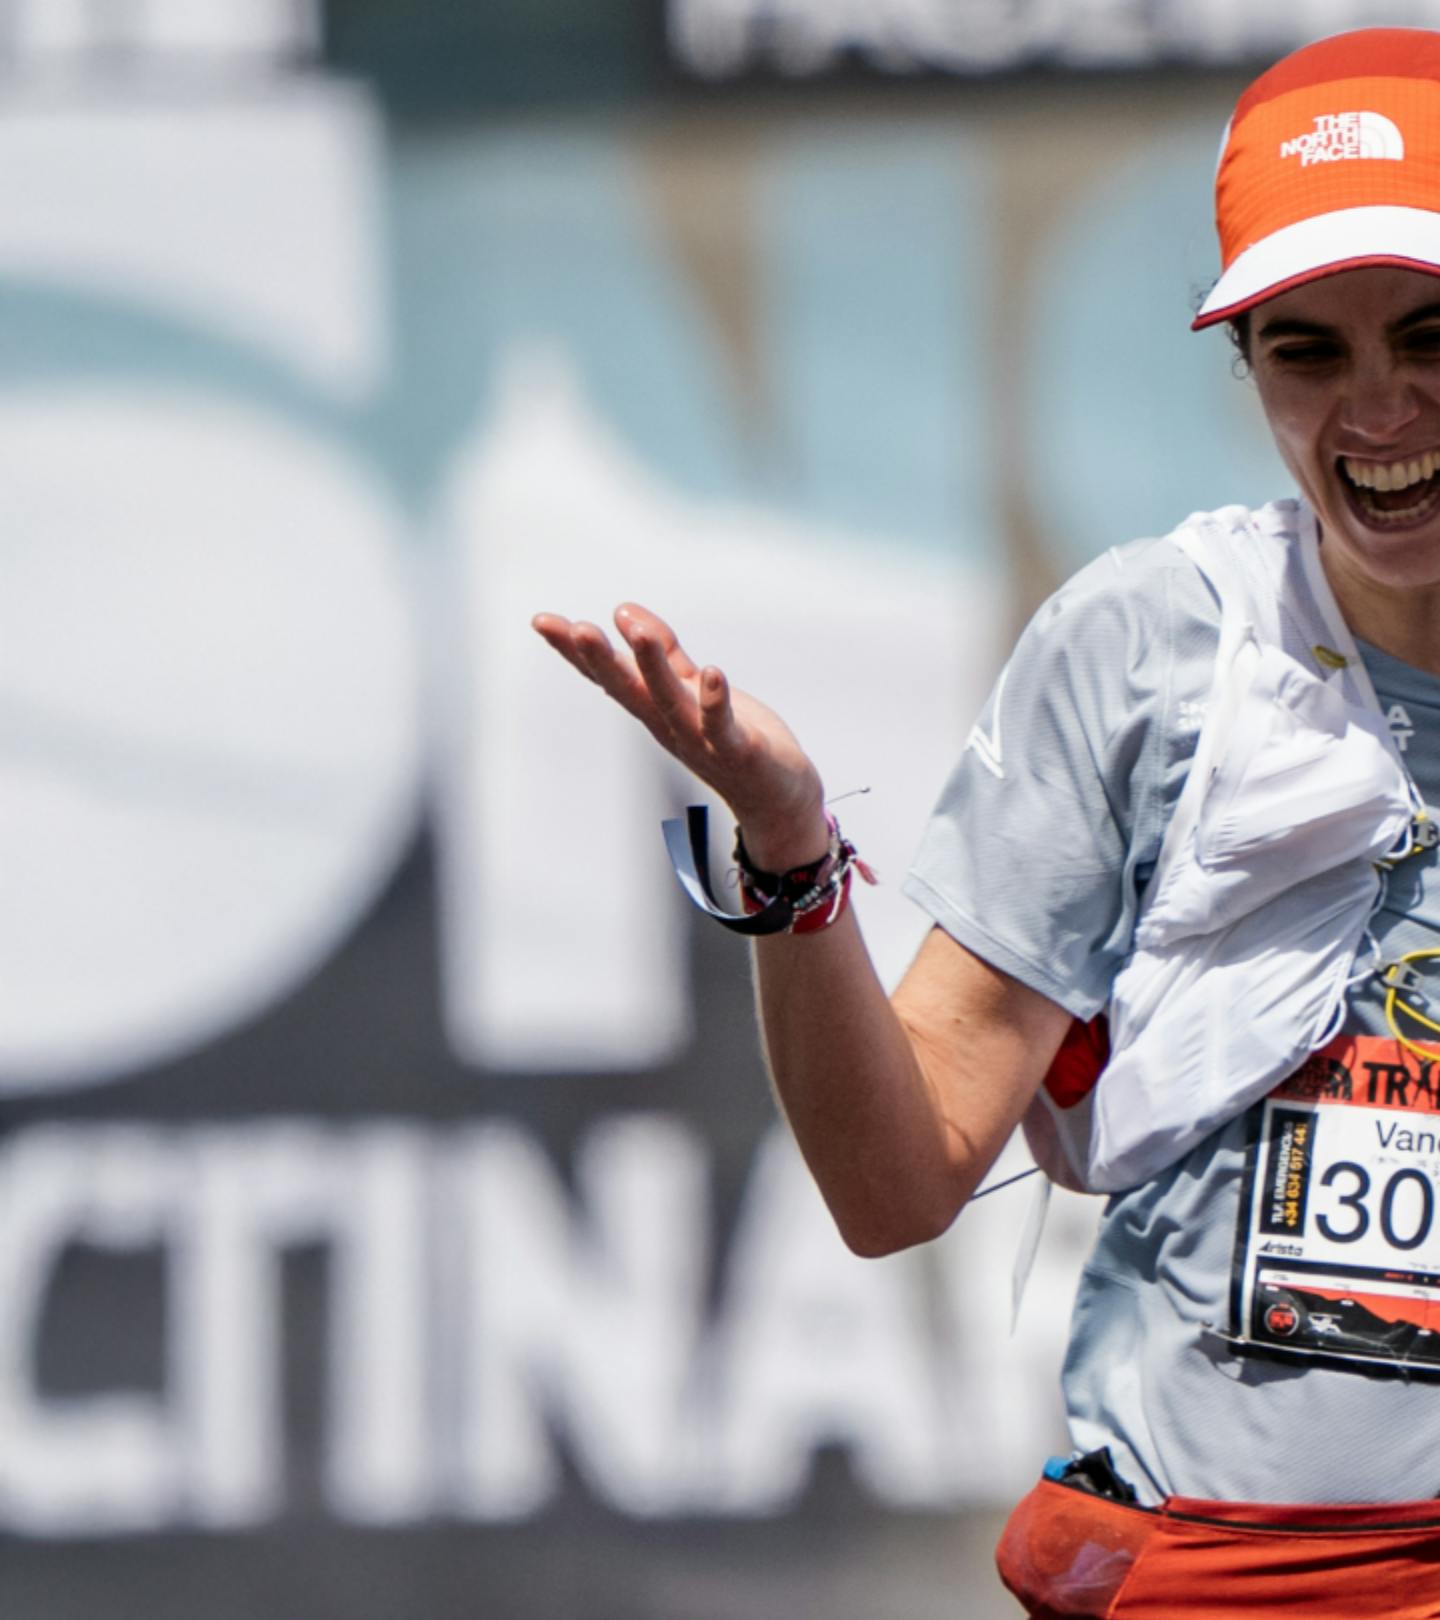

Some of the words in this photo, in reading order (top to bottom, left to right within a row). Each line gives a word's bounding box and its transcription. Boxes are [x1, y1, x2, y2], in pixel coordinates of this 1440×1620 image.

[1313, 111, 1360, 131] THE
[1280, 127, 1359, 158] NORTH
[1300, 146, 1360, 167] FACE
